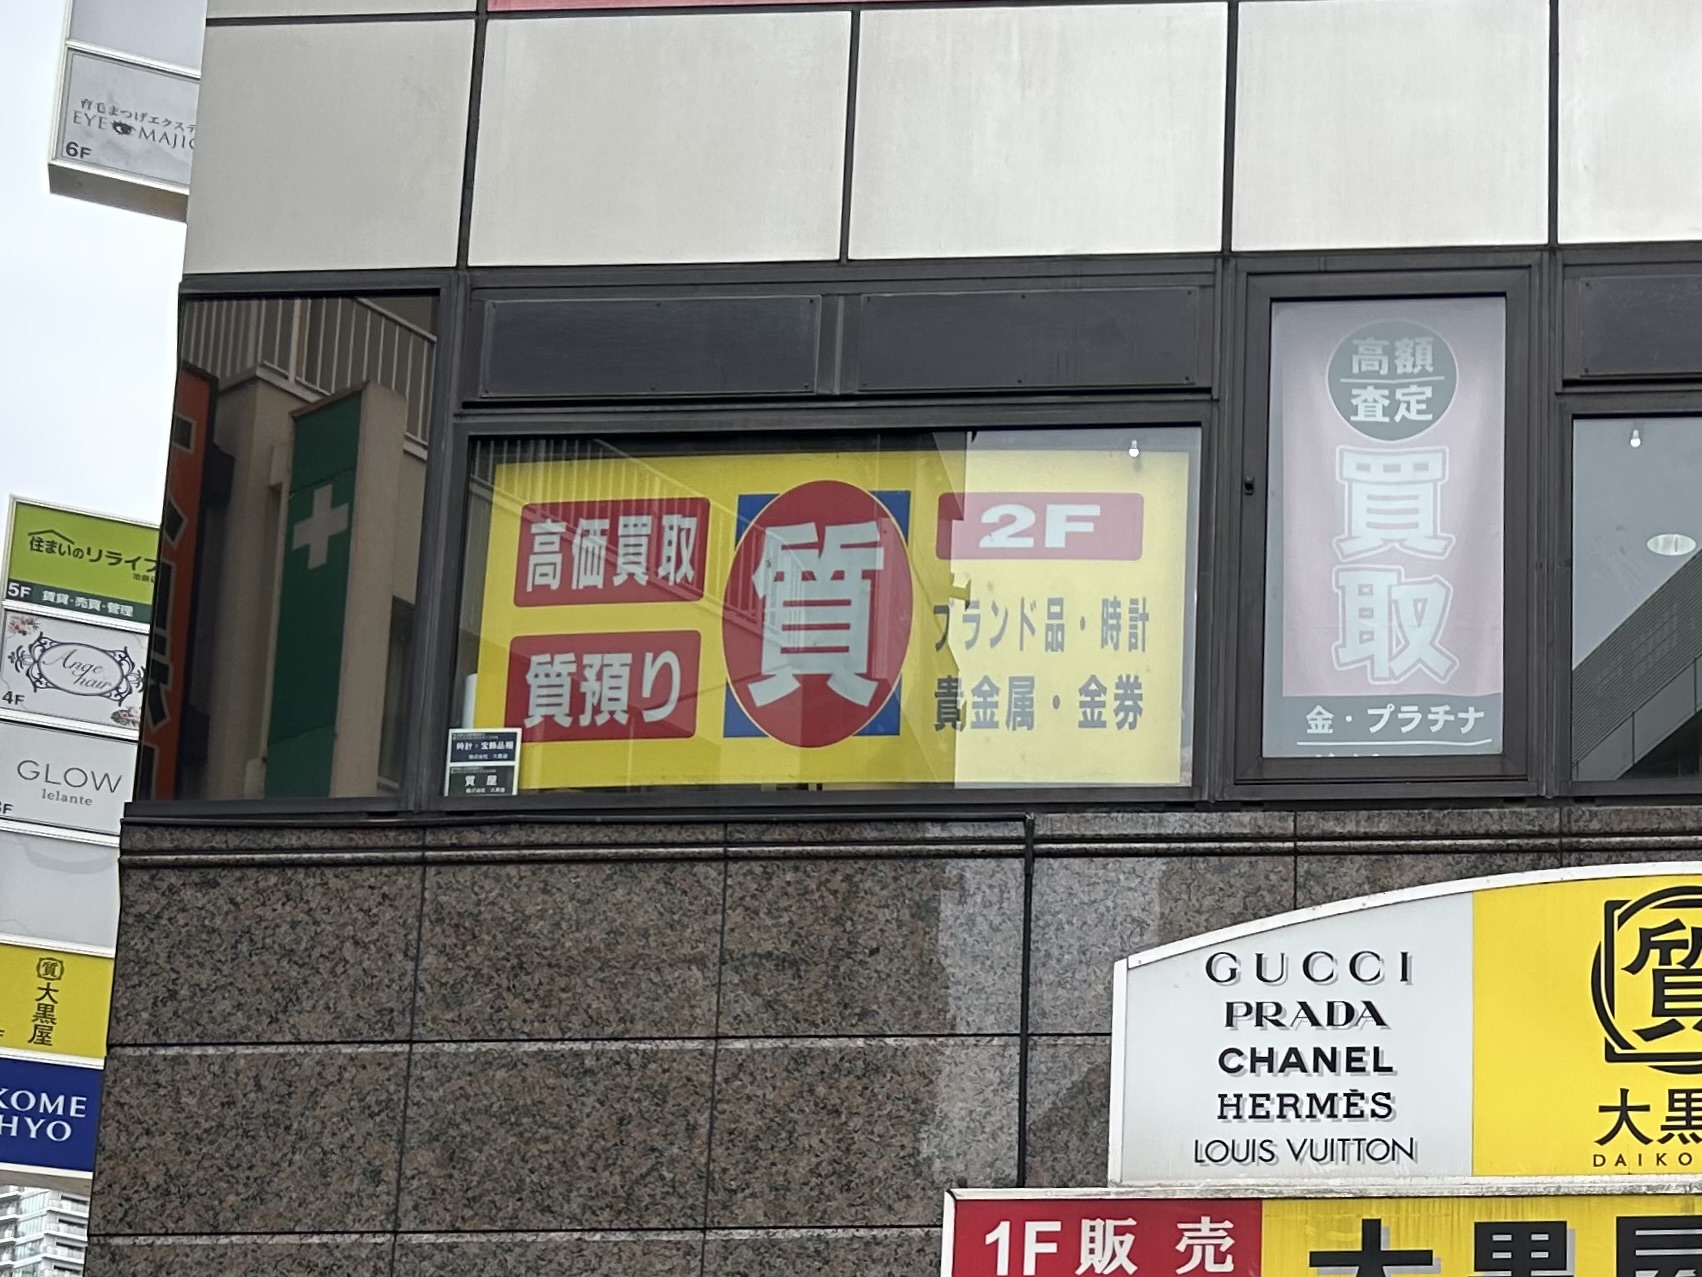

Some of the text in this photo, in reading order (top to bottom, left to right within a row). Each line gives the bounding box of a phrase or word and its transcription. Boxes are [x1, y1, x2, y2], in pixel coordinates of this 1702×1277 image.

[73, 110, 107, 130] EYE
[65, 141, 92, 158] 6F
[1352, 337, 1434, 375] 高額
[1350, 385, 1433, 423] 査定
[978, 503, 1102, 549] 2F
[526, 513, 698, 593] 高価買取
[1333, 446, 1457, 684] 買取
[8, 581, 32, 598] 5F
[748, 520, 886, 708] 質
[934, 595, 1151, 654] ブランド品・時計
[2, 690, 26, 705] 4F
[525, 649, 683, 728] 質預り
[933, 673, 1145, 732] 貴金属・金券
[1305, 703, 1486, 734] 金・プラチナ
[17, 759, 123, 793] GLOW
[41, 788, 93, 806] lelante
[1205, 950, 1412, 984] GUCCI
[27, 982, 60, 1047] 大黒屋
[1224, 1000, 1389, 1029] PRADA
[1218, 1045, 1395, 1074] CHANEL
[1217, 1088, 1394, 1119] HERMÈS
[1195, 1136, 1415, 1164] LOUIS VUITTON
[984, 1220, 1062, 1276] 1F
